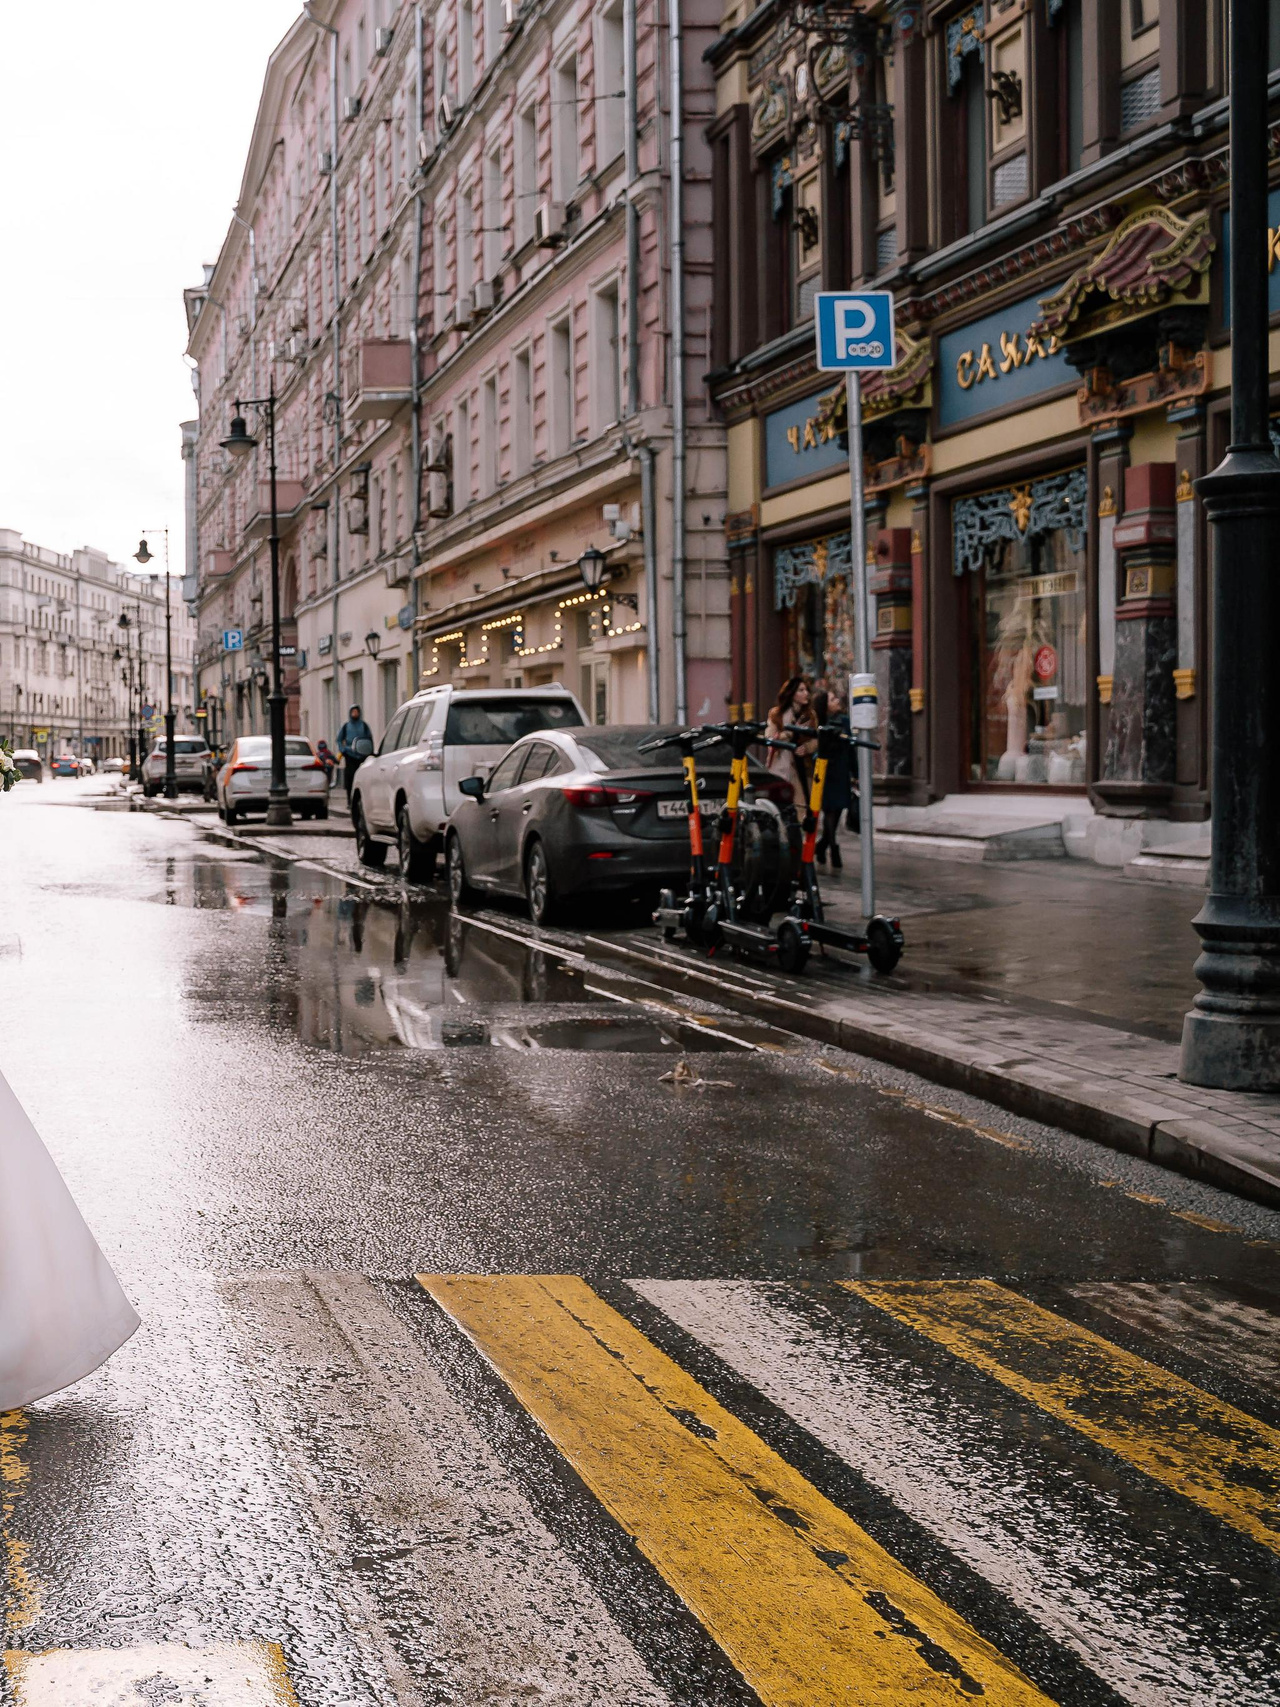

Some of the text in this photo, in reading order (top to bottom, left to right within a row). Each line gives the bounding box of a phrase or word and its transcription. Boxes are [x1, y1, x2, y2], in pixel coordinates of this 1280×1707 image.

[834, 299, 876, 359] P
[869, 344, 881, 355] 20
[228, 632, 240, 648] P
